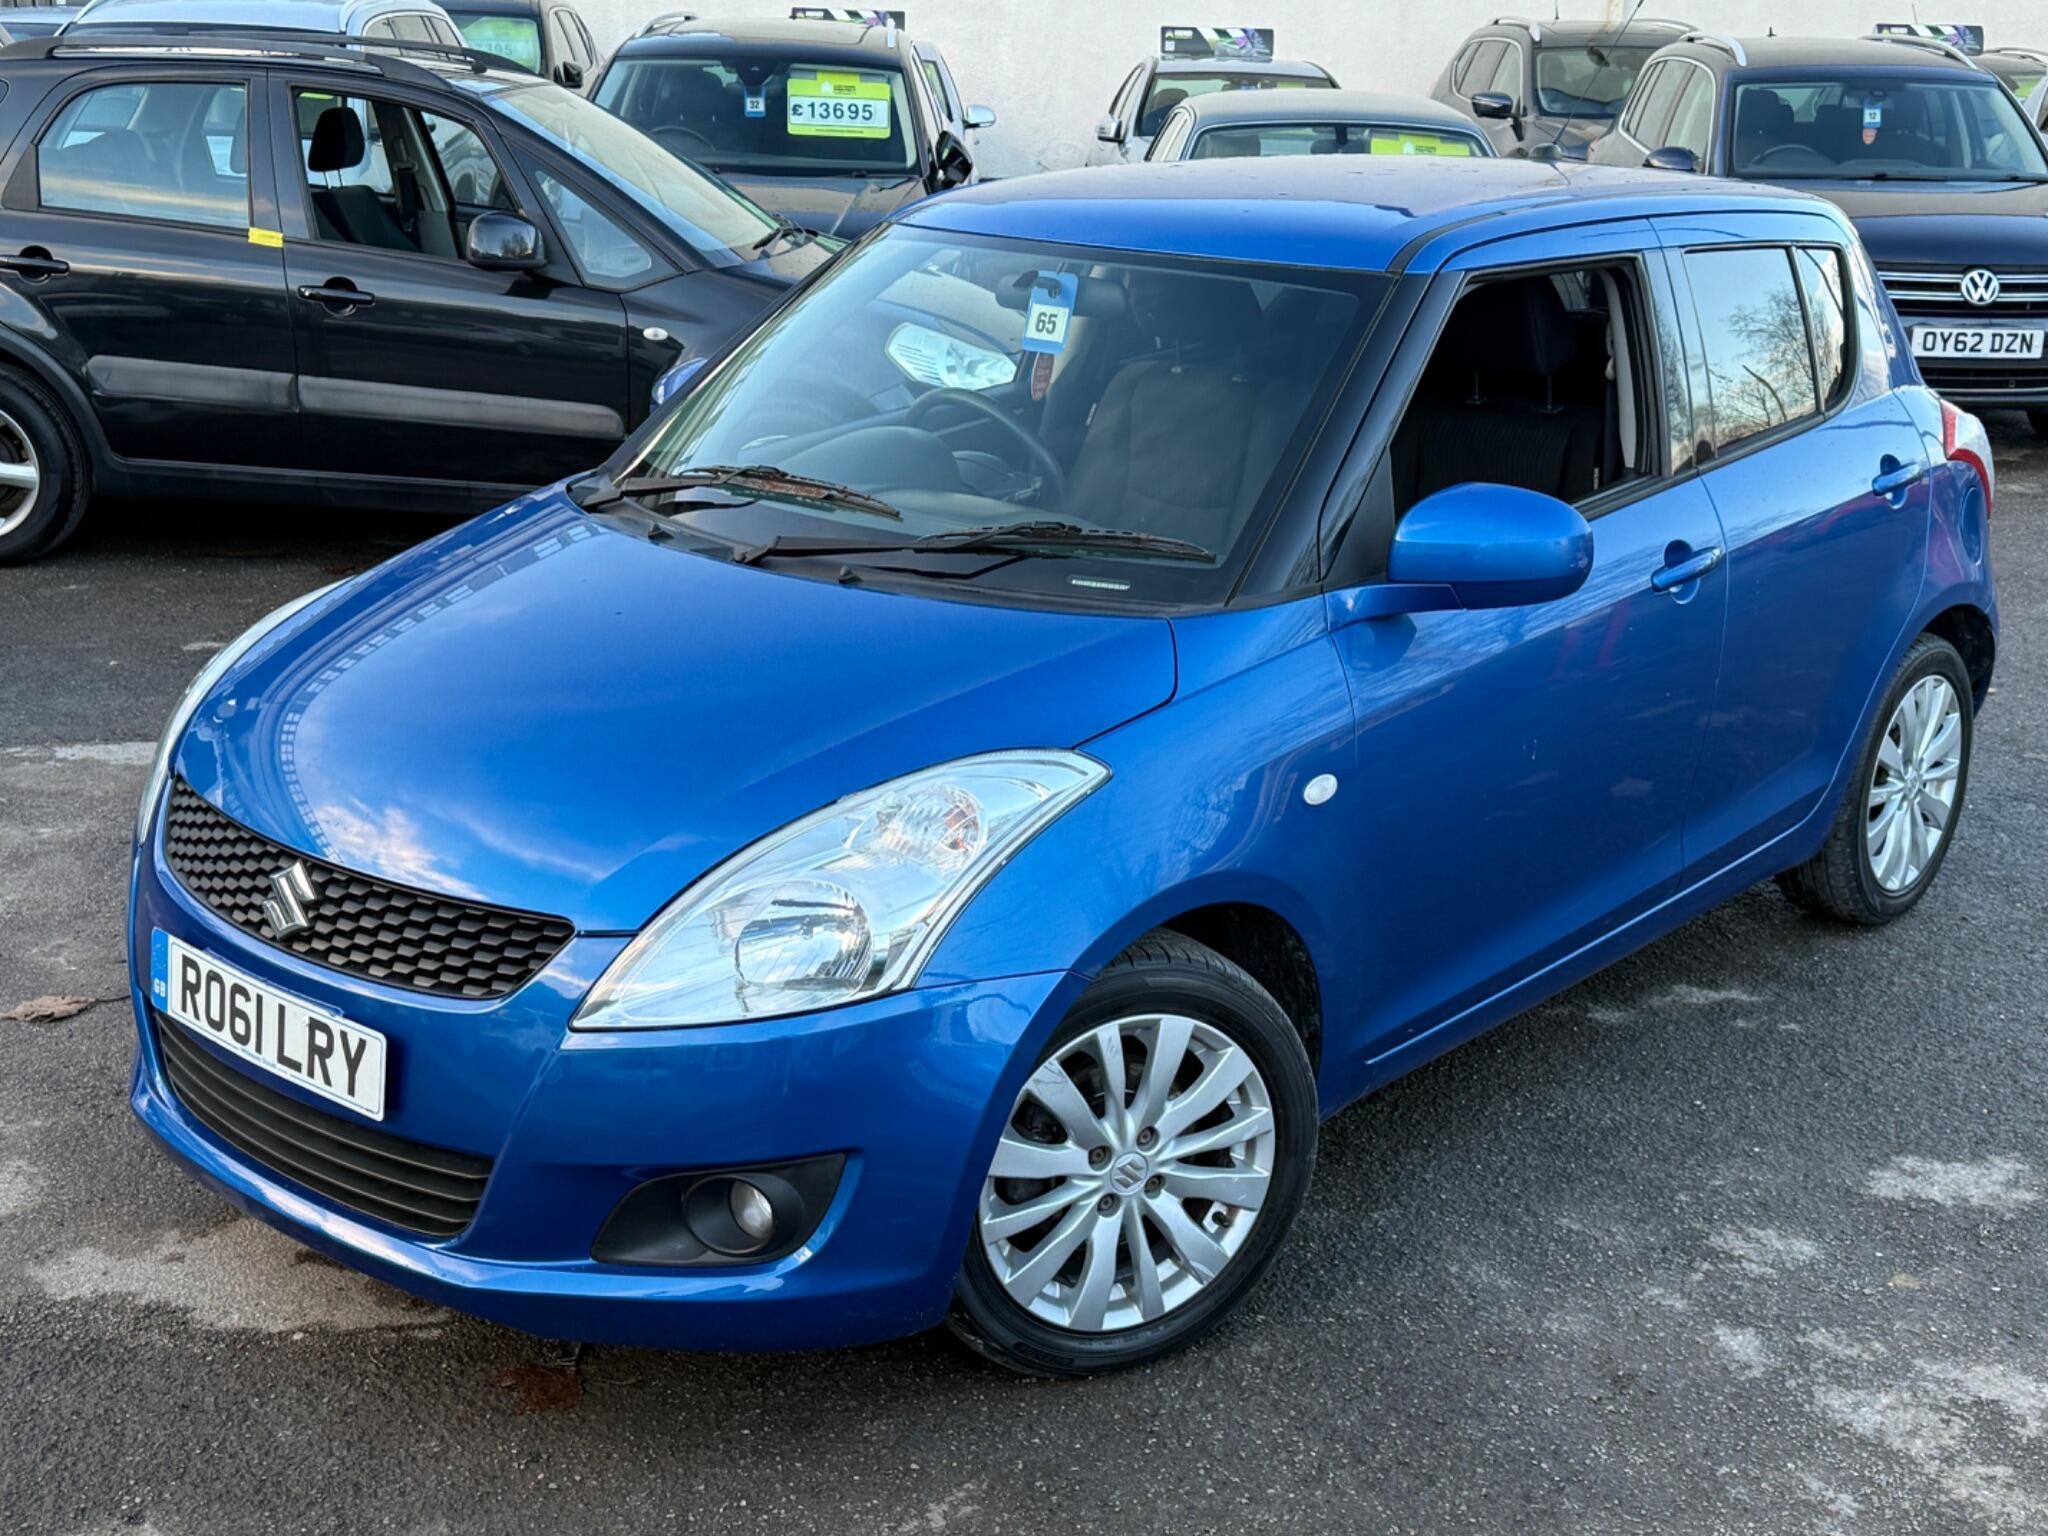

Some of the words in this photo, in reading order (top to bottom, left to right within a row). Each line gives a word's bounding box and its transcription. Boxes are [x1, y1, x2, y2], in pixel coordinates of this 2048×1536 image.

[791, 101, 874, 121] £13695
[1035, 311, 1058, 335] 65
[1922, 331, 1984, 353] OY62
[1989, 333, 2034, 354] DZN
[154, 977, 166, 998] GB
[181, 953, 264, 1056] RO61
[276, 1002, 367, 1098] LRY
